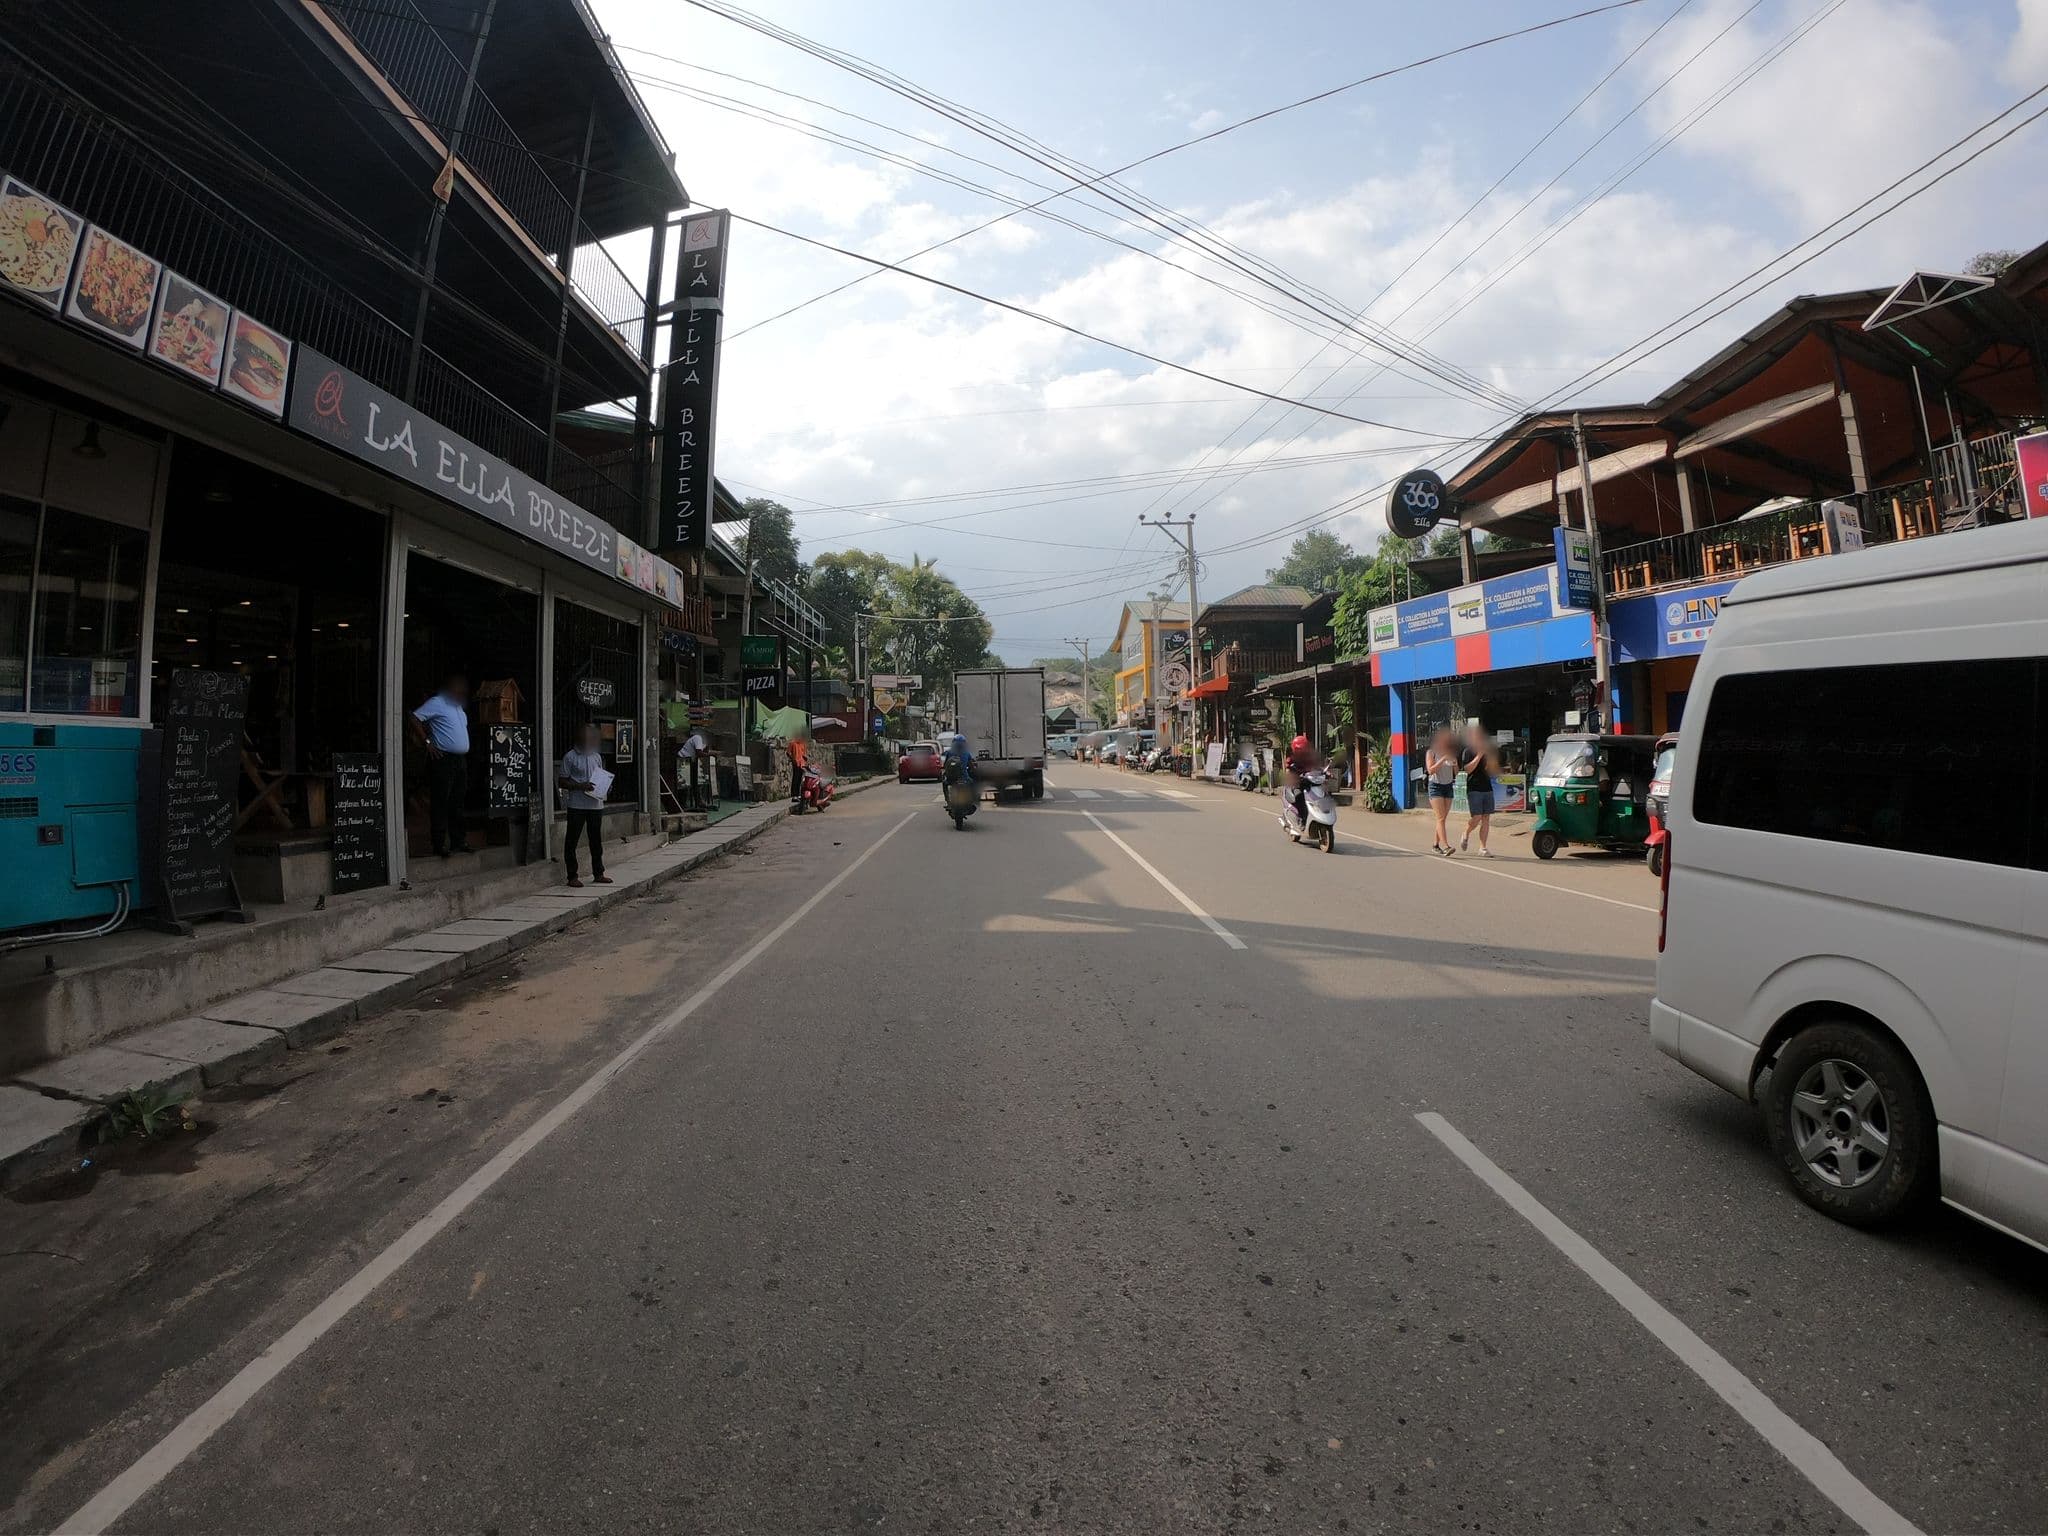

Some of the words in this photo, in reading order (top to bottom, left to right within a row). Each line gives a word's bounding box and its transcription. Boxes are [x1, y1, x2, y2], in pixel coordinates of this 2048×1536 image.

[689, 254, 708, 287] LA
[682, 304, 702, 385] ELLA
[364, 402, 419, 469] LA
[436, 439, 516, 517] ELLA
[528, 491, 611, 563] BREEZE
[675, 408, 697, 543] BREEZE
[1413, 517, 1431, 528] Ella
[1493, 590, 1521, 601] COLLECTION
[1498, 595, 1535, 609] COMMUNICATION
[1405, 610, 1428, 622] COLLECTION
[580, 680, 612, 696] SHEESHA
[746, 675, 775, 691] PIZZA
[494, 753, 508, 767] Buy
[507, 766, 524, 778] Beer
